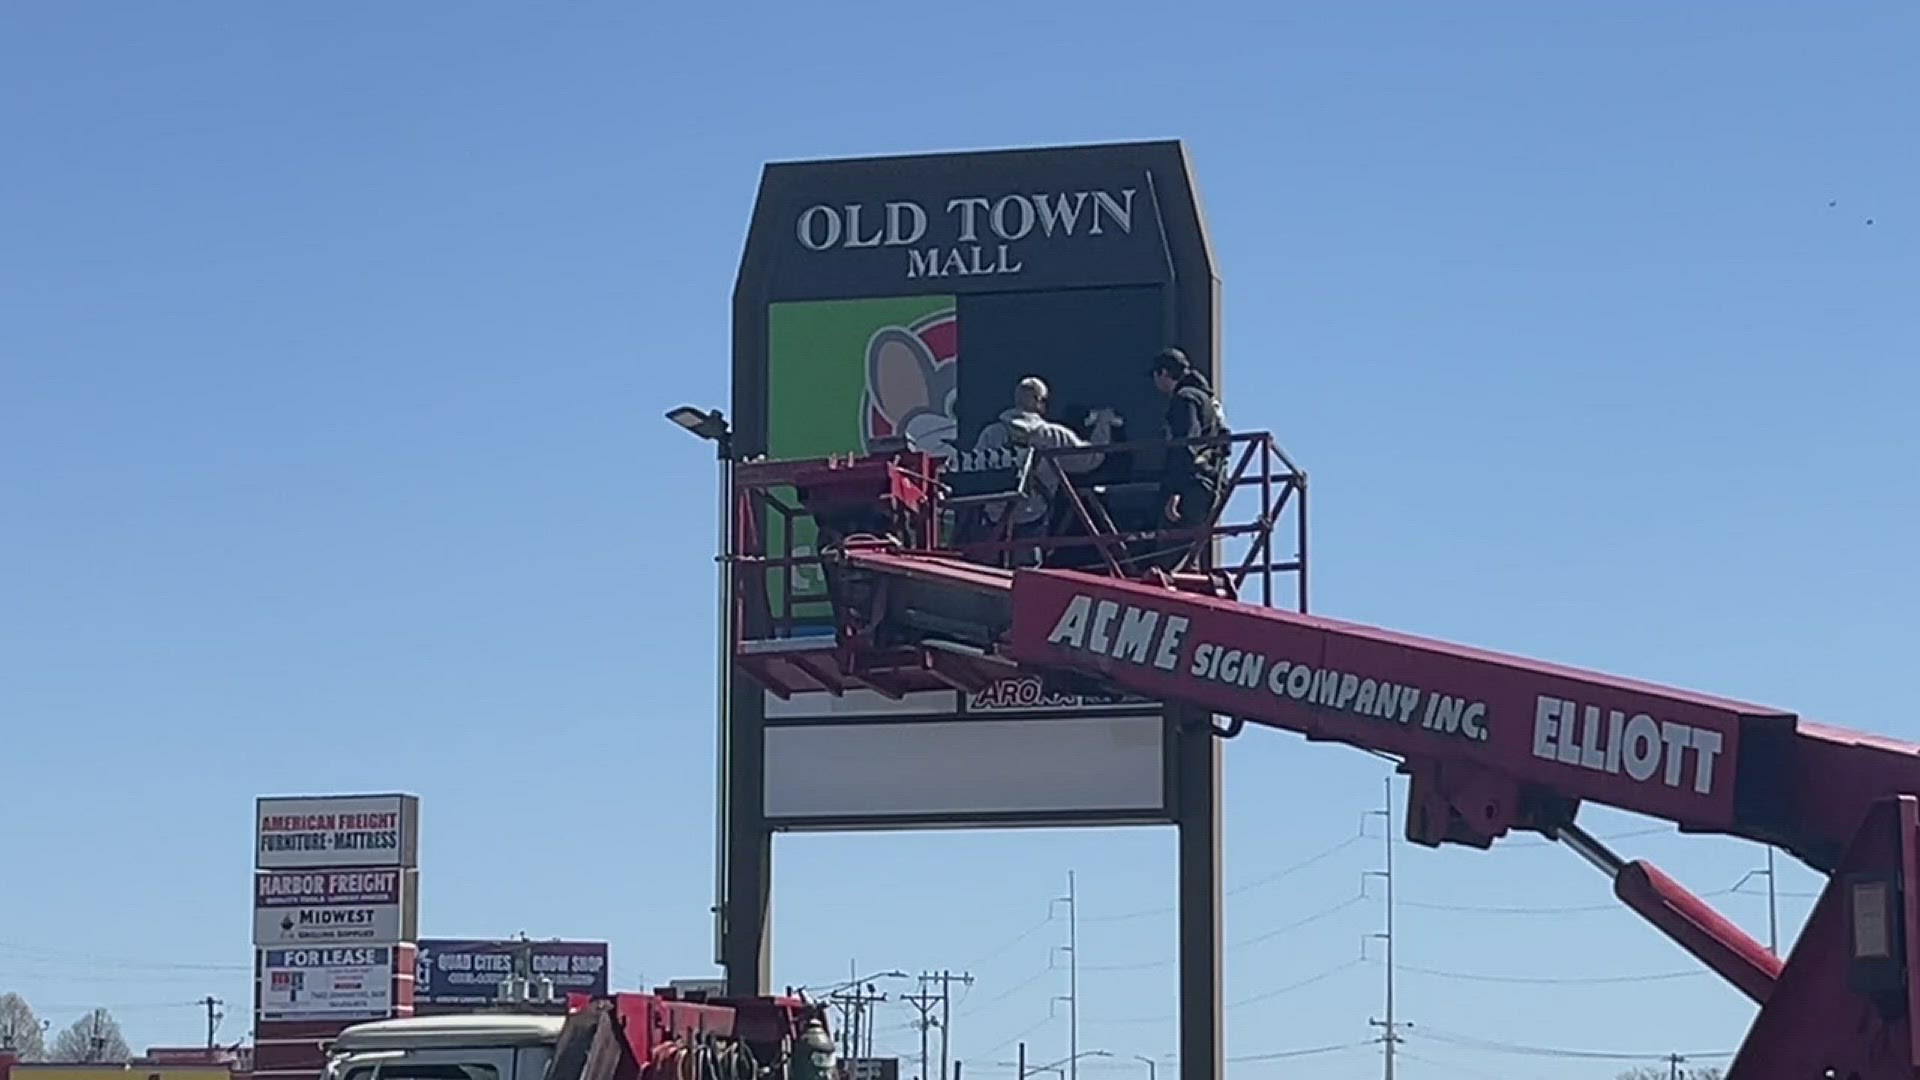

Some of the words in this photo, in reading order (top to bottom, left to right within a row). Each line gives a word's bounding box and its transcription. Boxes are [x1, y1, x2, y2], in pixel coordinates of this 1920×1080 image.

[797, 202, 927, 250] OLD
[946, 189, 1136, 240] TOWN
[907, 245, 1022, 278] MALL
[1048, 594, 1189, 671] ACME
[1191, 643, 1265, 689] SIGN
[1268, 660, 1420, 724] COMPANY
[1422, 692, 1489, 741] INC.
[1533, 695, 1722, 794] ELLIOTT
[262, 815, 336, 832] AMERICAN
[339, 813, 397, 830] FREIGHT
[259, 876, 324, 895] HARBOR
[328, 873, 396, 894] FREIGHT
[298, 910, 375, 924] MIDWEST
[284, 951, 320, 966] FOR
[323, 949, 375, 965] LEASE
[438, 953, 471, 970] QUAD
[475, 954, 511, 971] CITIES
[572, 955, 603, 972] SHOP
